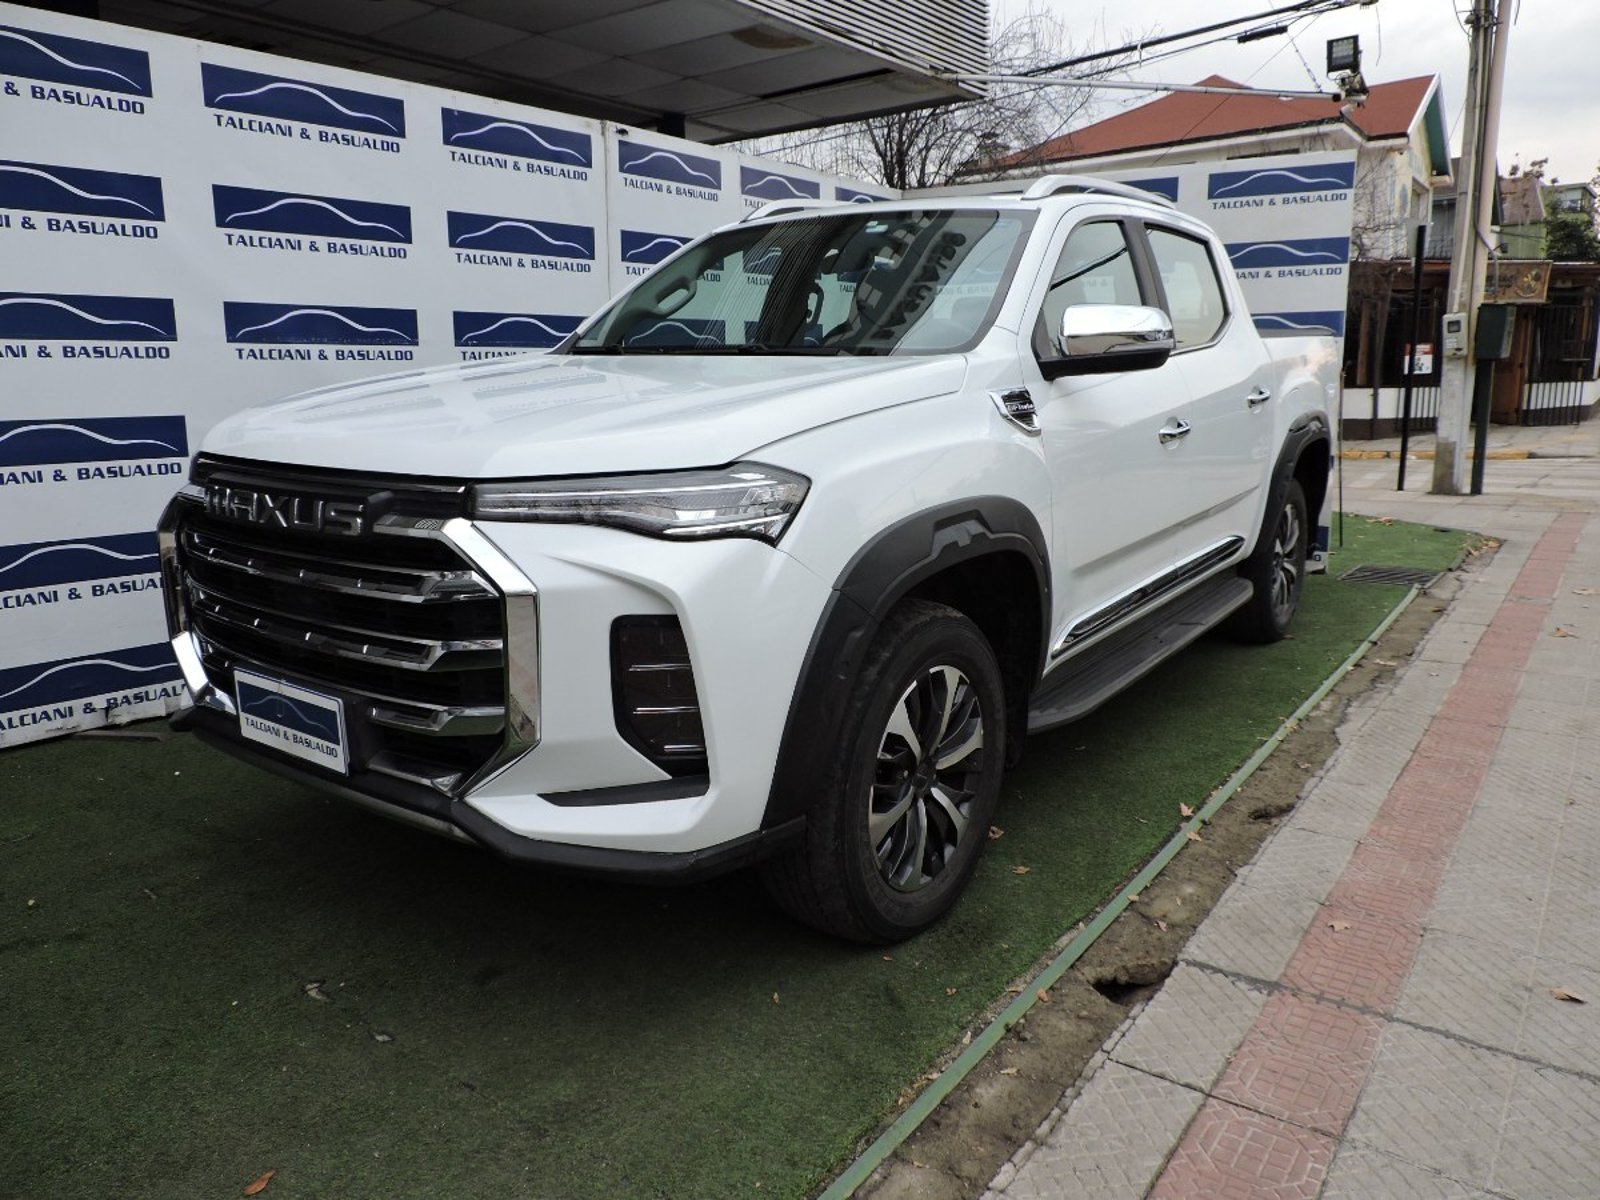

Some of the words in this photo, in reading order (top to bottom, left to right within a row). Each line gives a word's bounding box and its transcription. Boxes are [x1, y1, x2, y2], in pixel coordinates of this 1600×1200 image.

[4, 81, 20, 97] &
[30, 85, 145, 115] BASUALDO
[214, 113, 293, 138] TALCIANI
[300, 127, 311, 140] &
[318, 130, 400, 153] BASUALDO
[449, 150, 507, 169] TALCIANI
[513, 161, 521, 171] &
[526, 162, 588, 181] BASUALDO
[623, 176, 663, 192] TALCIANI
[666, 185, 672, 194] &
[676, 186, 718, 202] BASUALDO
[1212, 199, 1264, 210] TALCIANI
[1268, 197, 1276, 206] &
[1282, 192, 1347, 204] BASUALDO
[21, 216, 36, 230] &
[47, 218, 158, 239] BASUALDO
[225, 232, 301, 251] TALCIANI
[308, 240, 320, 252] &
[327, 241, 407, 259] BASUALDO
[455, 252, 512, 267] TALCIANI
[517, 258, 526, 268] &
[531, 259, 591, 273] BASUALDO
[1236, 271, 1260, 280] IANI
[1264, 270, 1272, 278] &
[1278, 267, 1342, 278] BASUALDO
[37, 345, 52, 358] &
[62, 346, 170, 360] BASUALDO
[236, 348, 311, 361] TALCIANI
[318, 349, 329, 361] &
[336, 349, 413, 361] BASUALDO
[0, 470, 43, 486] IANI
[53, 469, 67, 482] &
[77, 462, 182, 481] BASUALDO
[204, 483, 364, 536] MAXUS
[0, 590, 58, 610] CIANI
[68, 587, 82, 600] &
[91, 577, 164, 597] BASUA
[0, 706, 73, 731] ALCIANI
[83, 702, 97, 714] &
[106, 683, 187, 710] BASUAL
[245, 717, 280, 738] TALCIANI
[283, 730, 290, 740] &
[292, 734, 338, 758] BASUALDO
